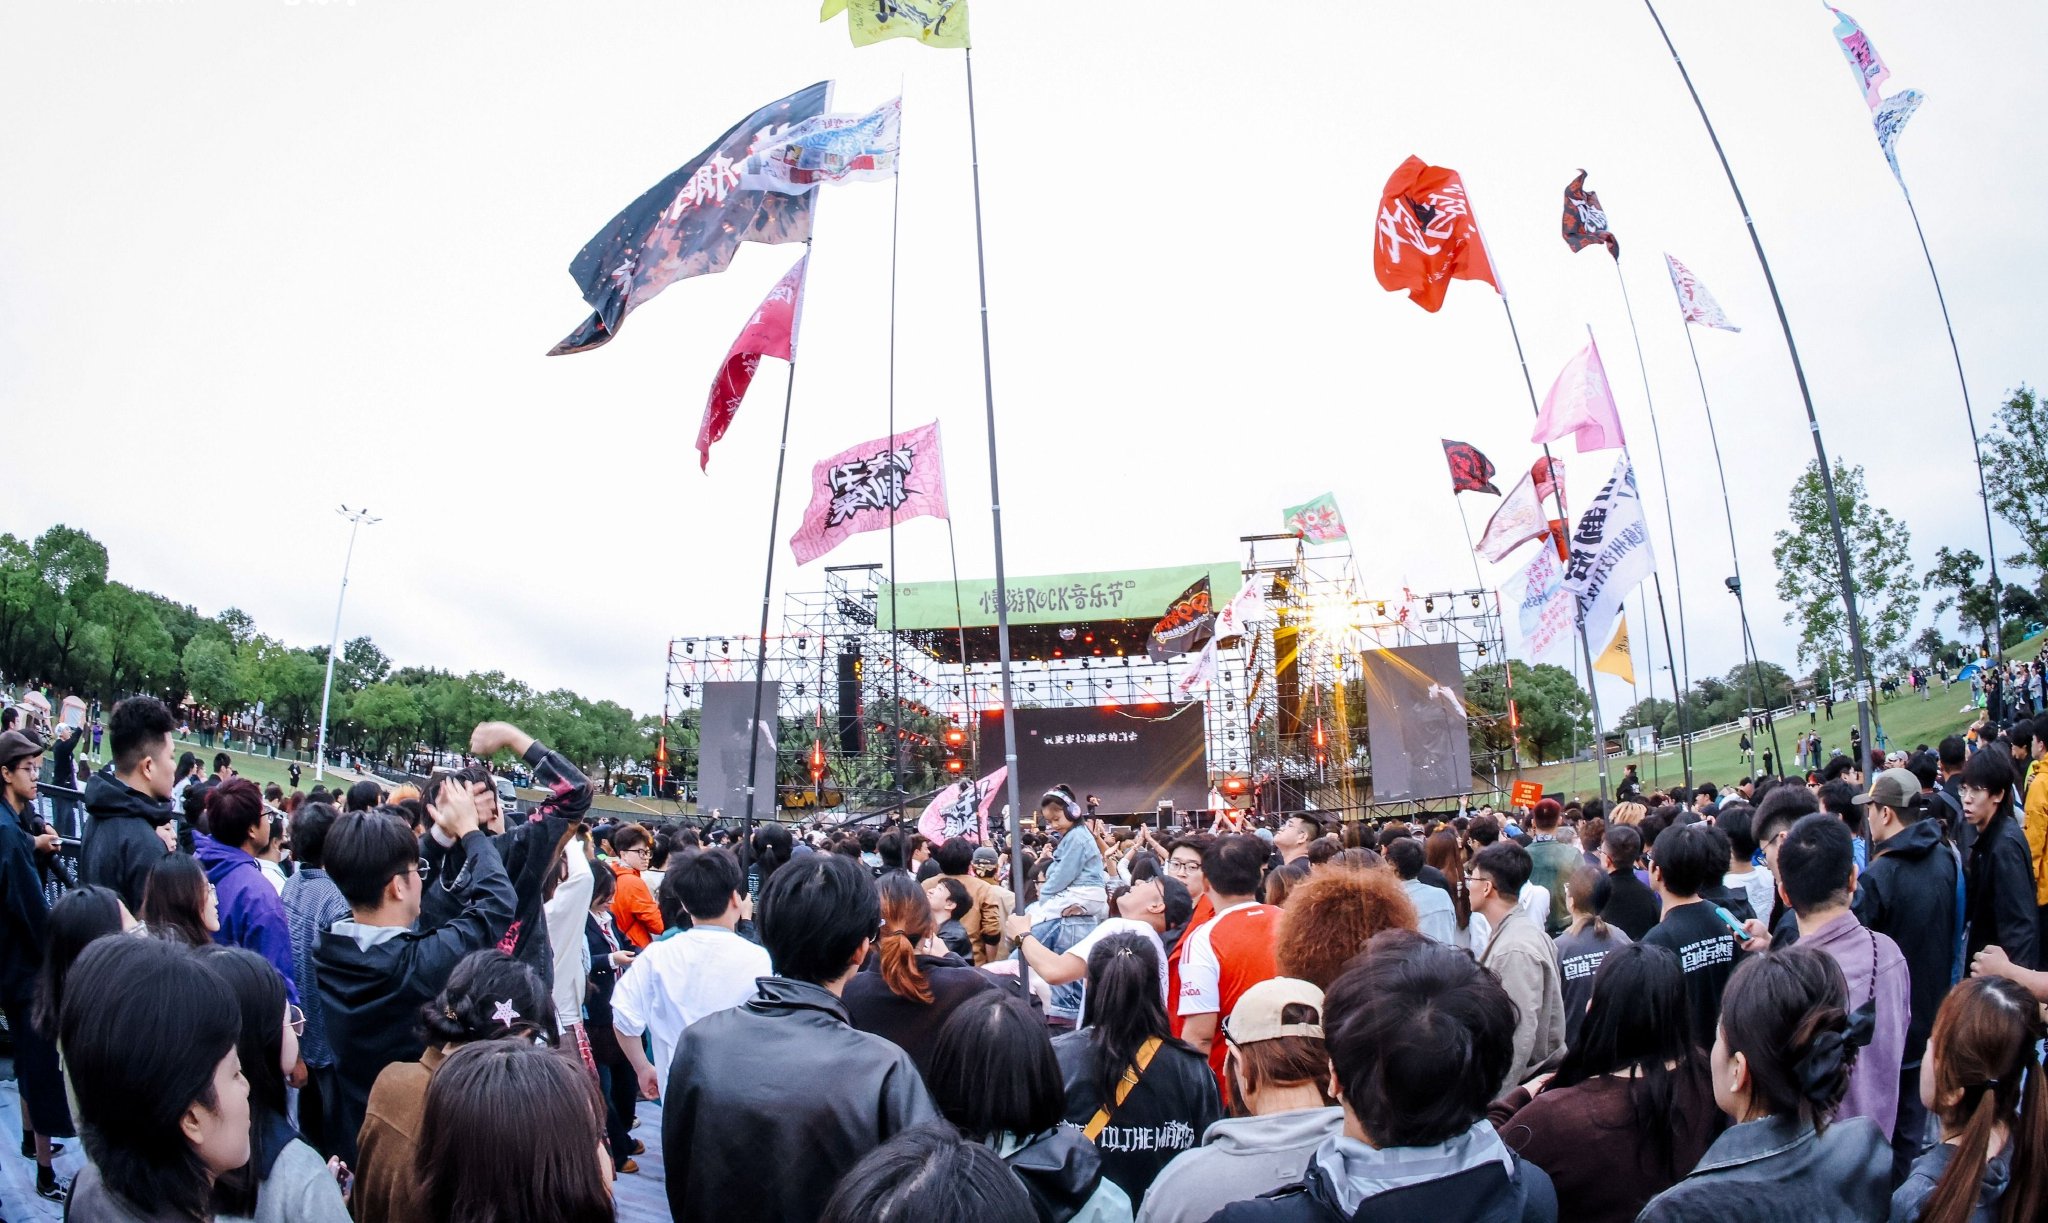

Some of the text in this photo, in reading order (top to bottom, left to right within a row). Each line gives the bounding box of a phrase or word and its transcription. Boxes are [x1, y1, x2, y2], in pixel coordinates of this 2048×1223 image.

[1584, 951, 1604, 959] SOME
[1564, 959, 1602, 977] 自由与
